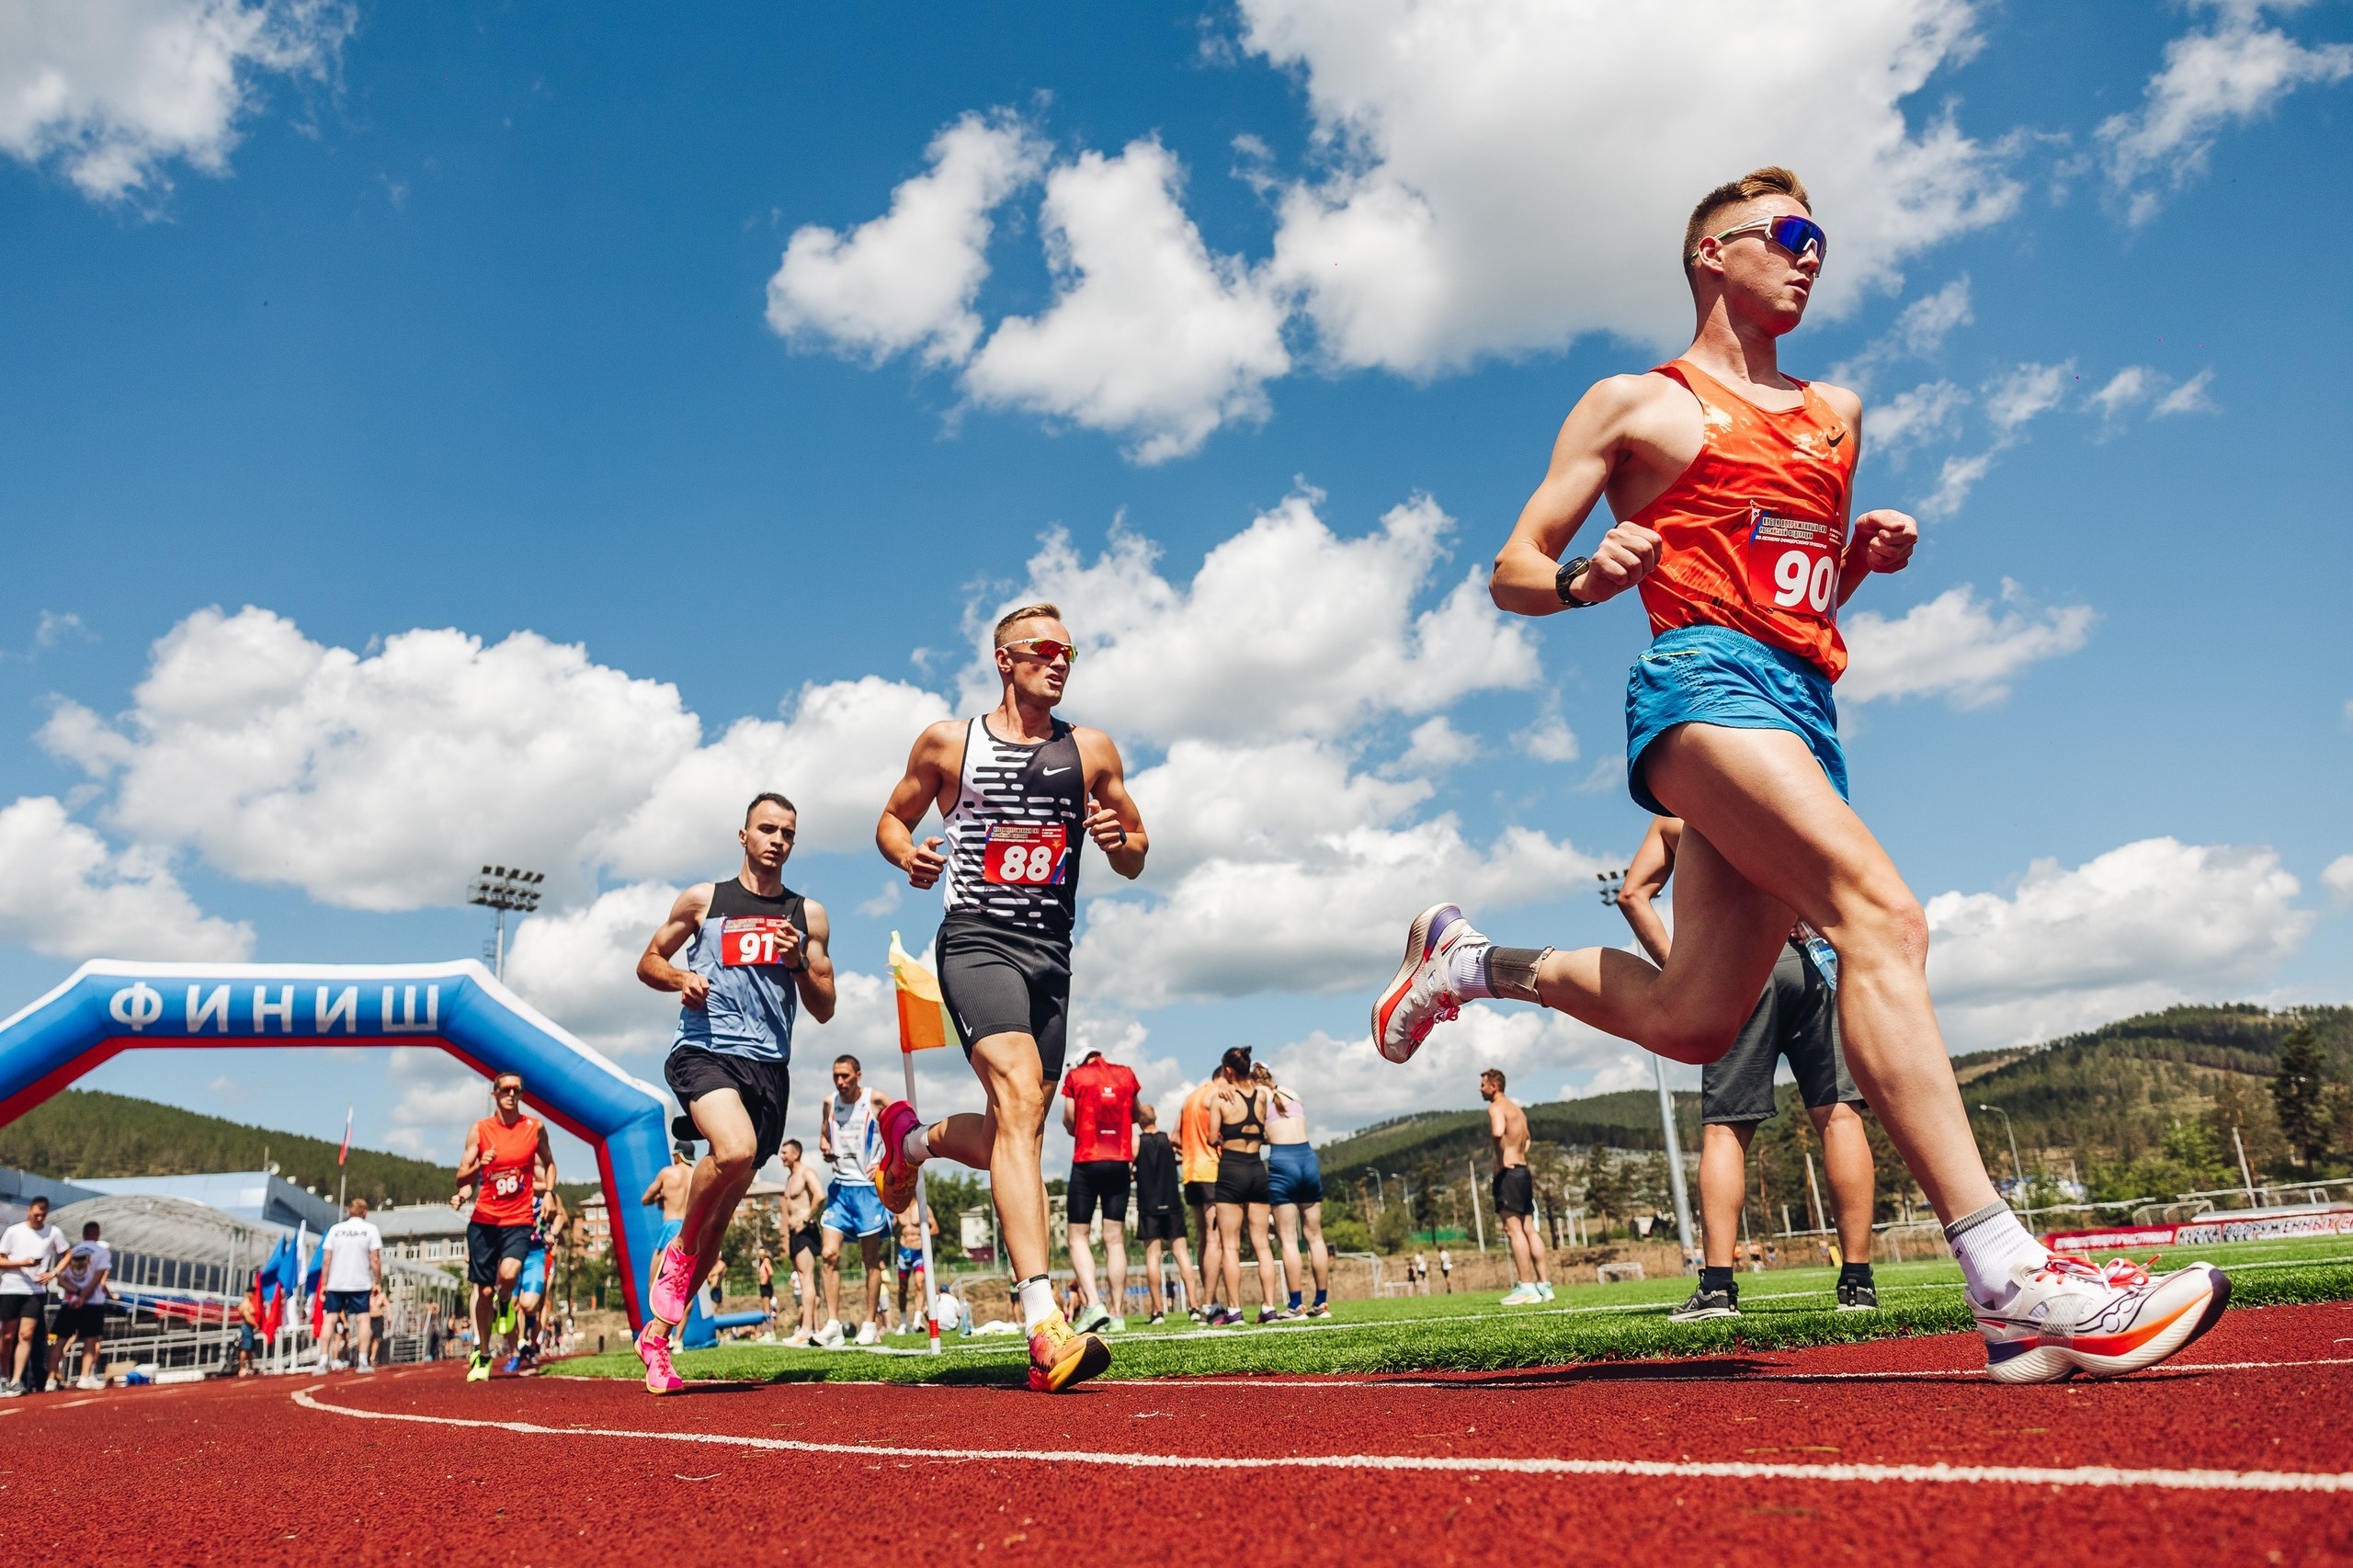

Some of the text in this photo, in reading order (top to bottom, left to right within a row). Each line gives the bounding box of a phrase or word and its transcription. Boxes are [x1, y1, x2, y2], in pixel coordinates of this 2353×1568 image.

[1774, 551, 1834, 612] 90
[1000, 846, 1052, 881] 88
[739, 932, 774, 963] 91
[108, 981, 439, 1033] ФИНИШ
[495, 1176, 517, 1196] 96
